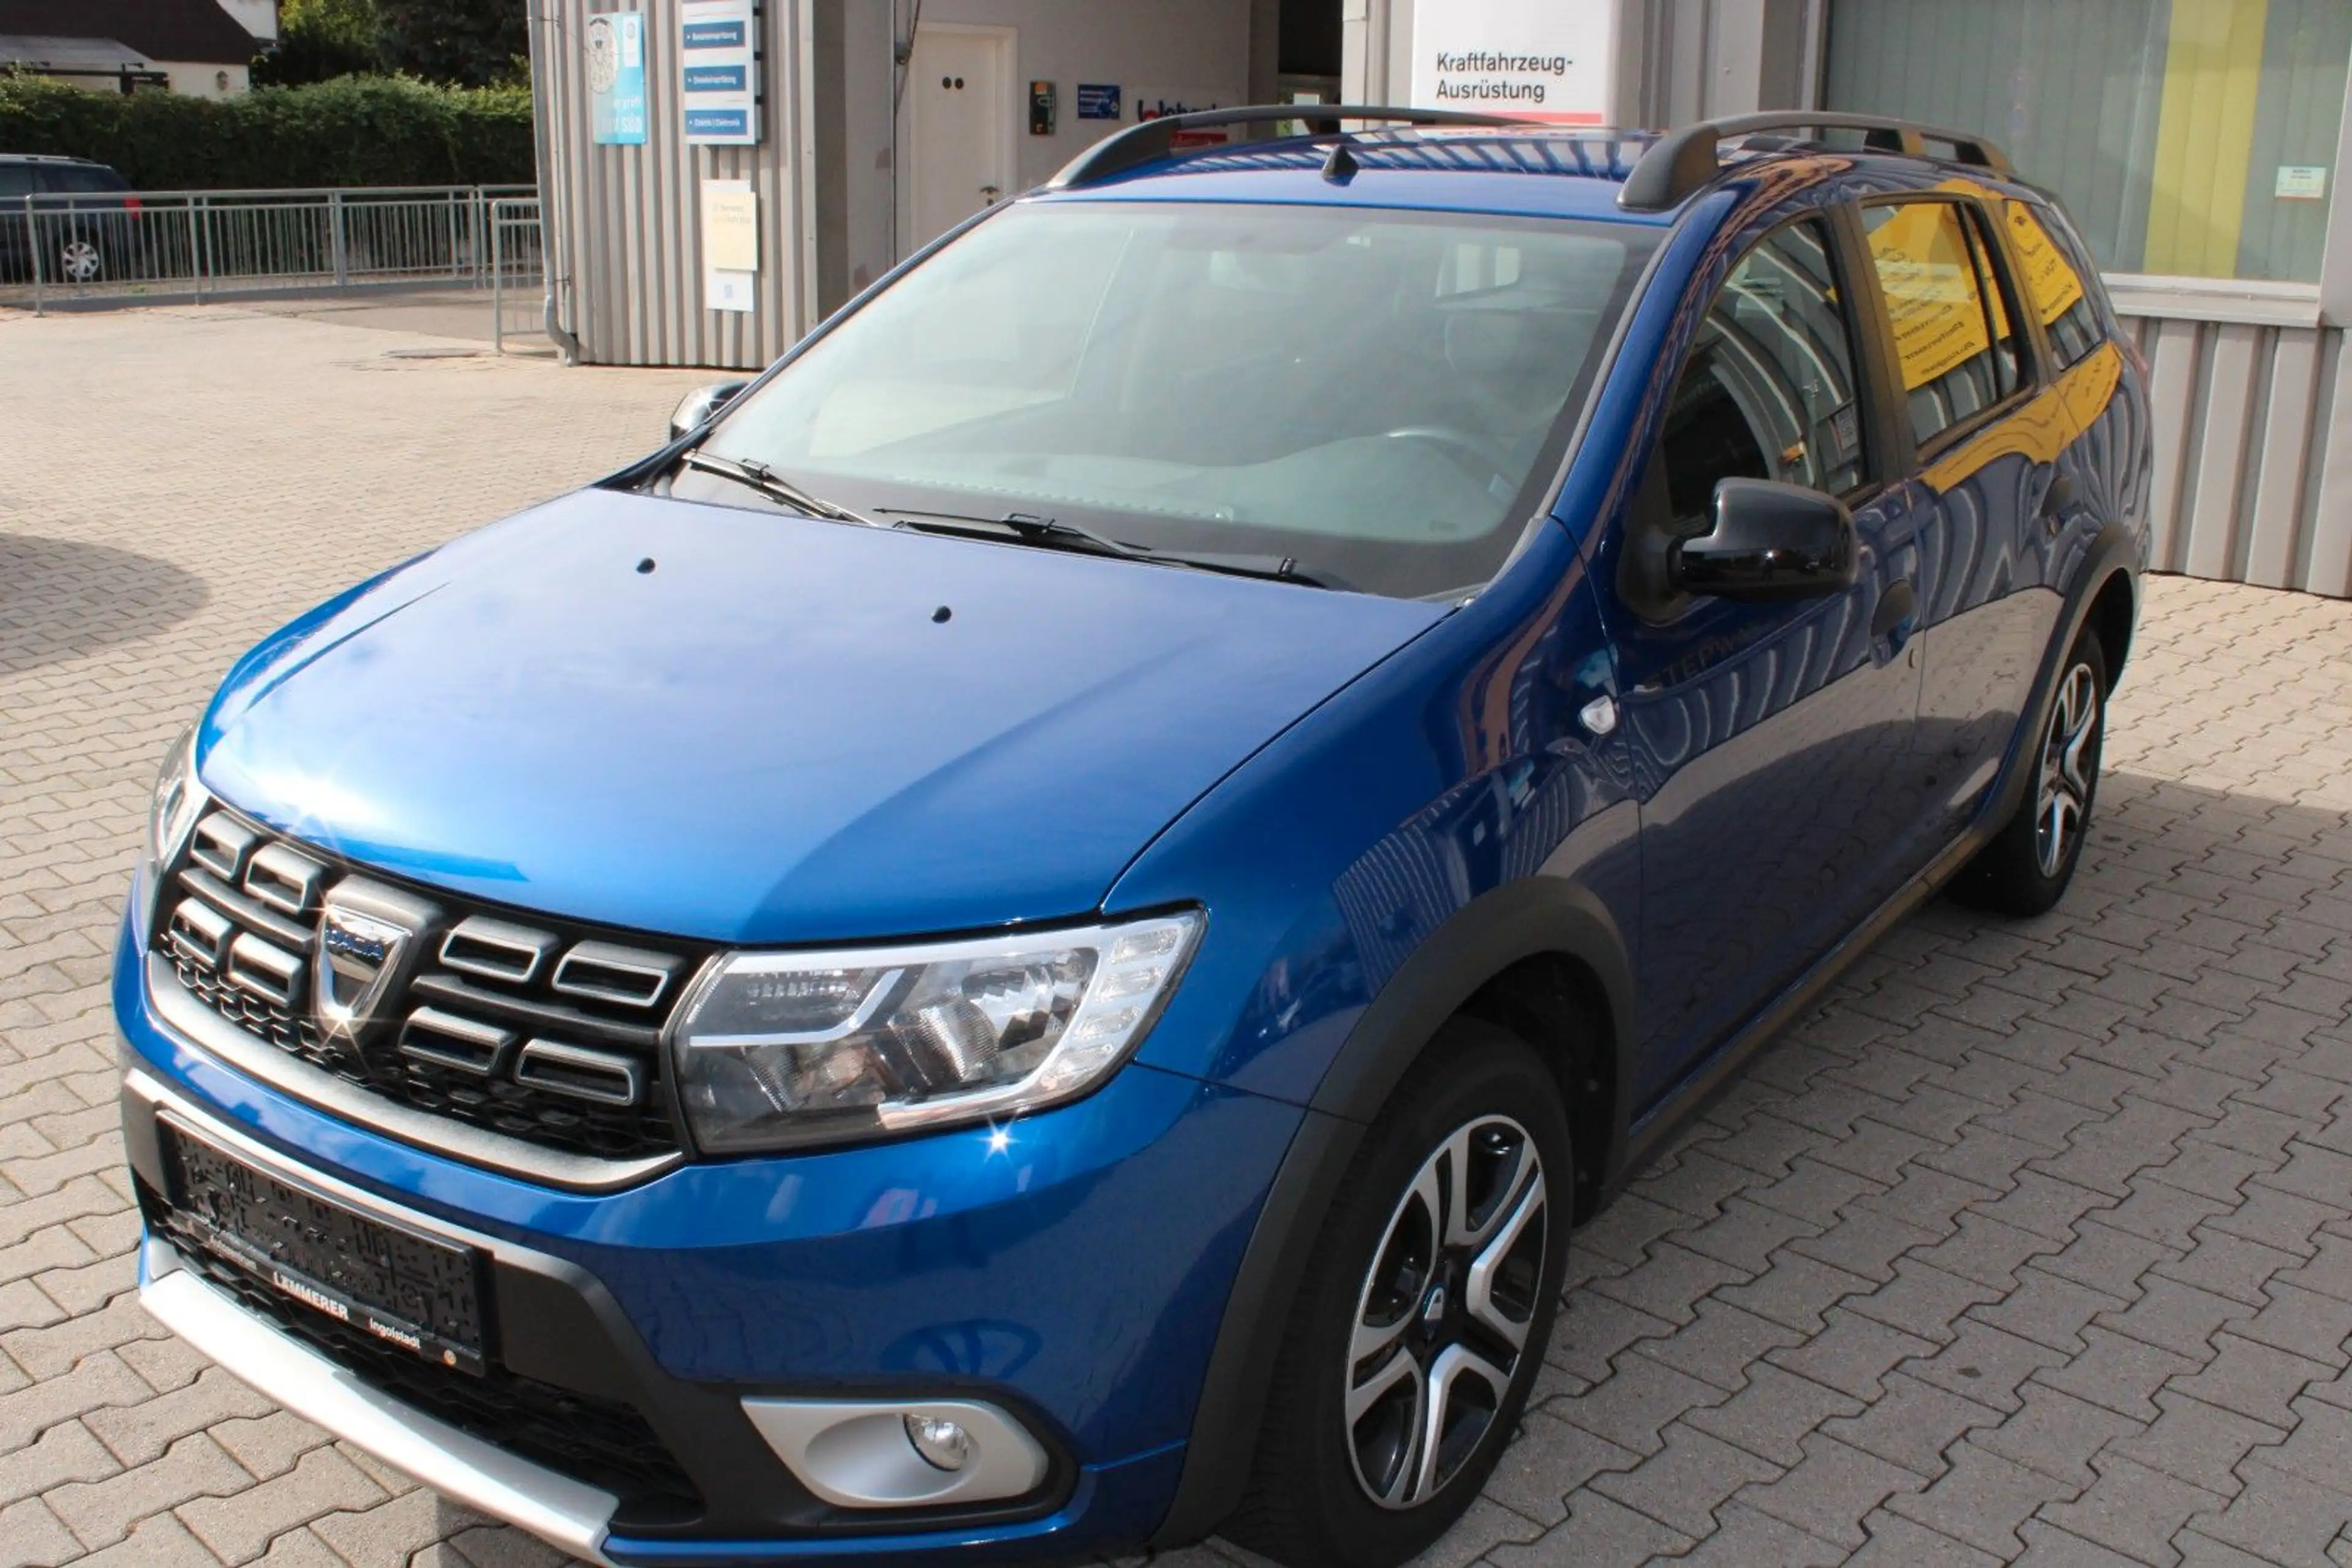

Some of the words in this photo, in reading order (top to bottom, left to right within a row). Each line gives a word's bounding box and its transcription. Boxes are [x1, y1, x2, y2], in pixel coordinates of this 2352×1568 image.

[1436, 53, 1573, 76] Kraftfahrzeug-
[1436, 79, 1545, 104] Ausrüstung
[369, 1317, 421, 1349] Ingolstadt
